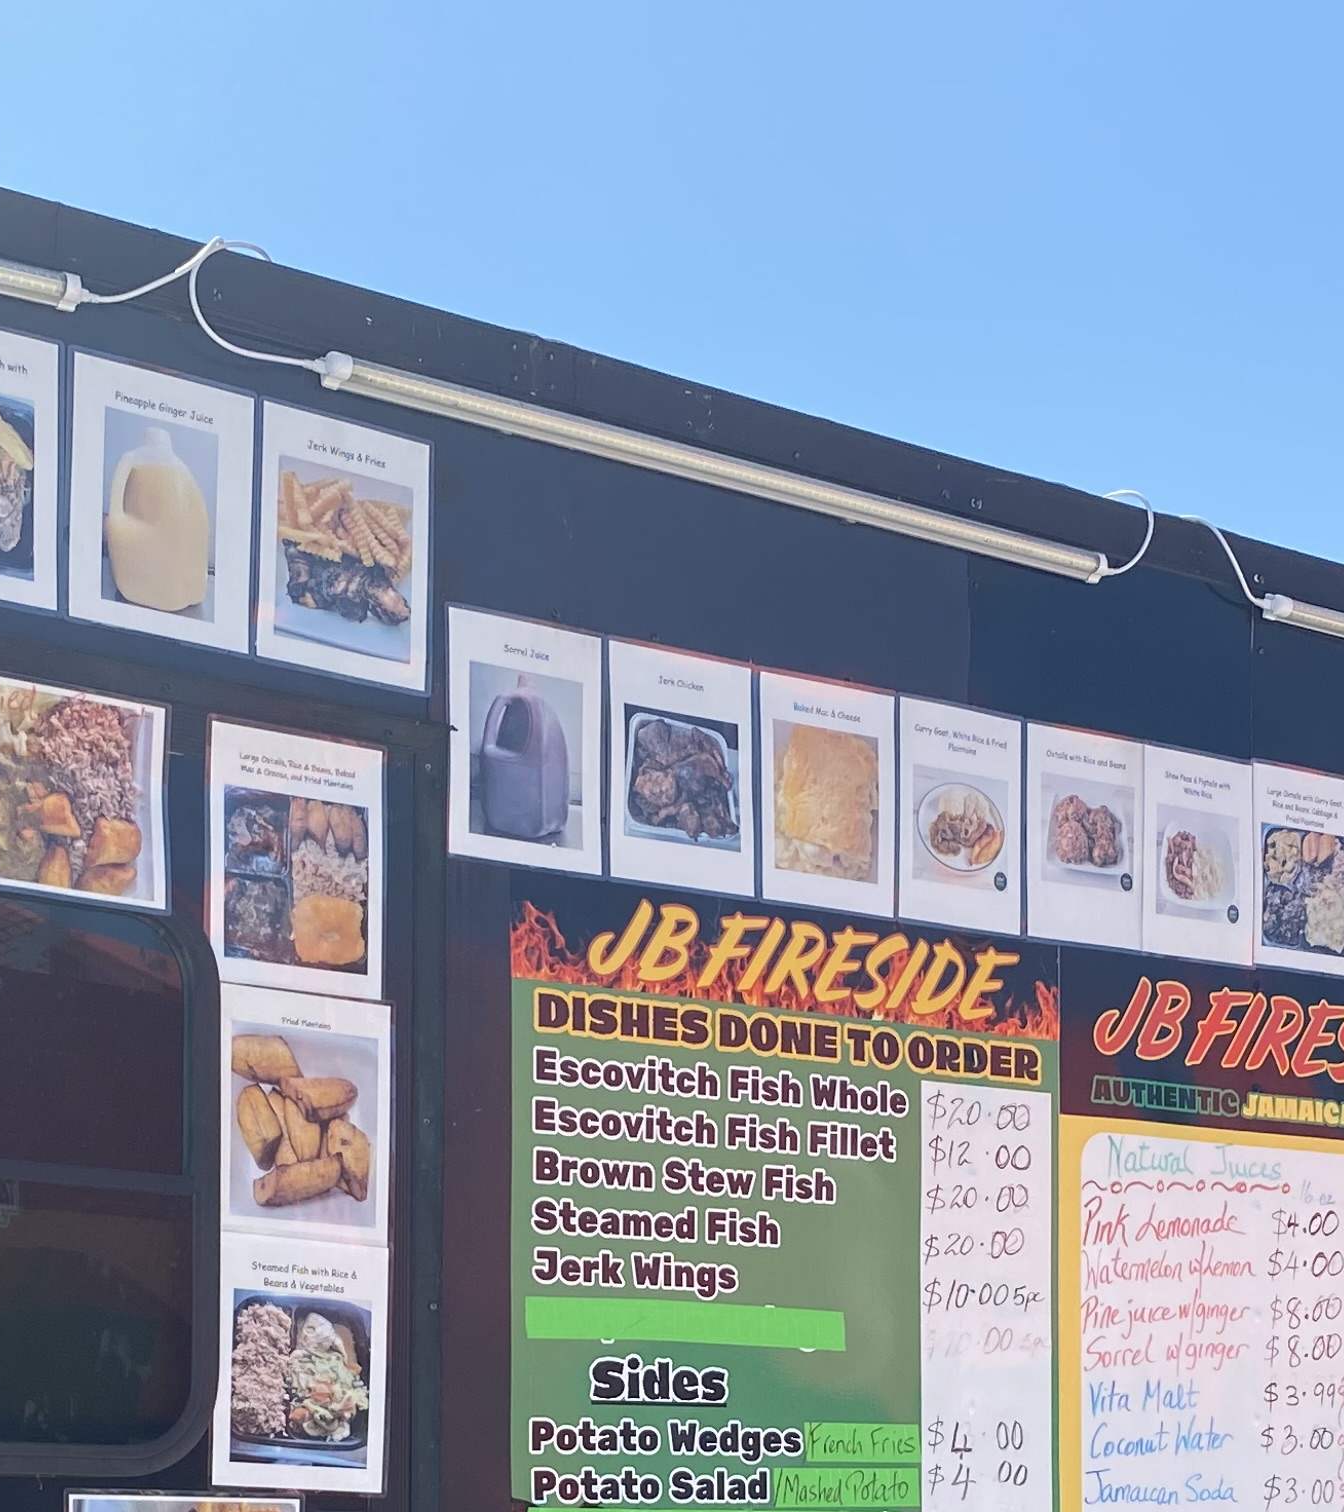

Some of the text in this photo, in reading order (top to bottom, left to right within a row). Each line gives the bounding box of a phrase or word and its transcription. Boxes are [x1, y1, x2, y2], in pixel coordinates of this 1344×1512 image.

[6, 361, 28, 376] with
[115, 391, 214, 425] Pineapple Ginger Juice
[307, 439, 387, 469] Jerk Wings Fries
[589, 899, 1021, 1022] JB FIRESIDE
[537, 992, 1041, 1081] DISHES DONE TO ORDER
[1092, 976, 1191, 1061] JB
[534, 1049, 909, 1116] Escovitch Fish Whole
[1091, 1075, 1240, 1117] AUTHENTIC
[533, 1099, 897, 1161] Escovitch Fish Fillet
[534, 1149, 836, 1204] Brown Stew Fish
[1107, 1135, 1282, 1181] Natural Juices
[532, 1200, 781, 1247] Steamed Fish
[1083, 1196, 1128, 1247] Pink
[251, 1261, 349, 1280] Steamed Fish with Rice
[263, 1277, 345, 1293] Beans Vegetables
[533, 1249, 739, 1299] Jerk Wings
[590, 1357, 728, 1402] Sides
[1089, 1379, 1199, 1415] Vita Malt
[530, 1418, 803, 1462] Potato Wedges
[1089, 1422, 1234, 1461] Coconut Water
[530, 1468, 770, 1505] Potato Salad
[1085, 1468, 1240, 1507] Jamaican Soda
